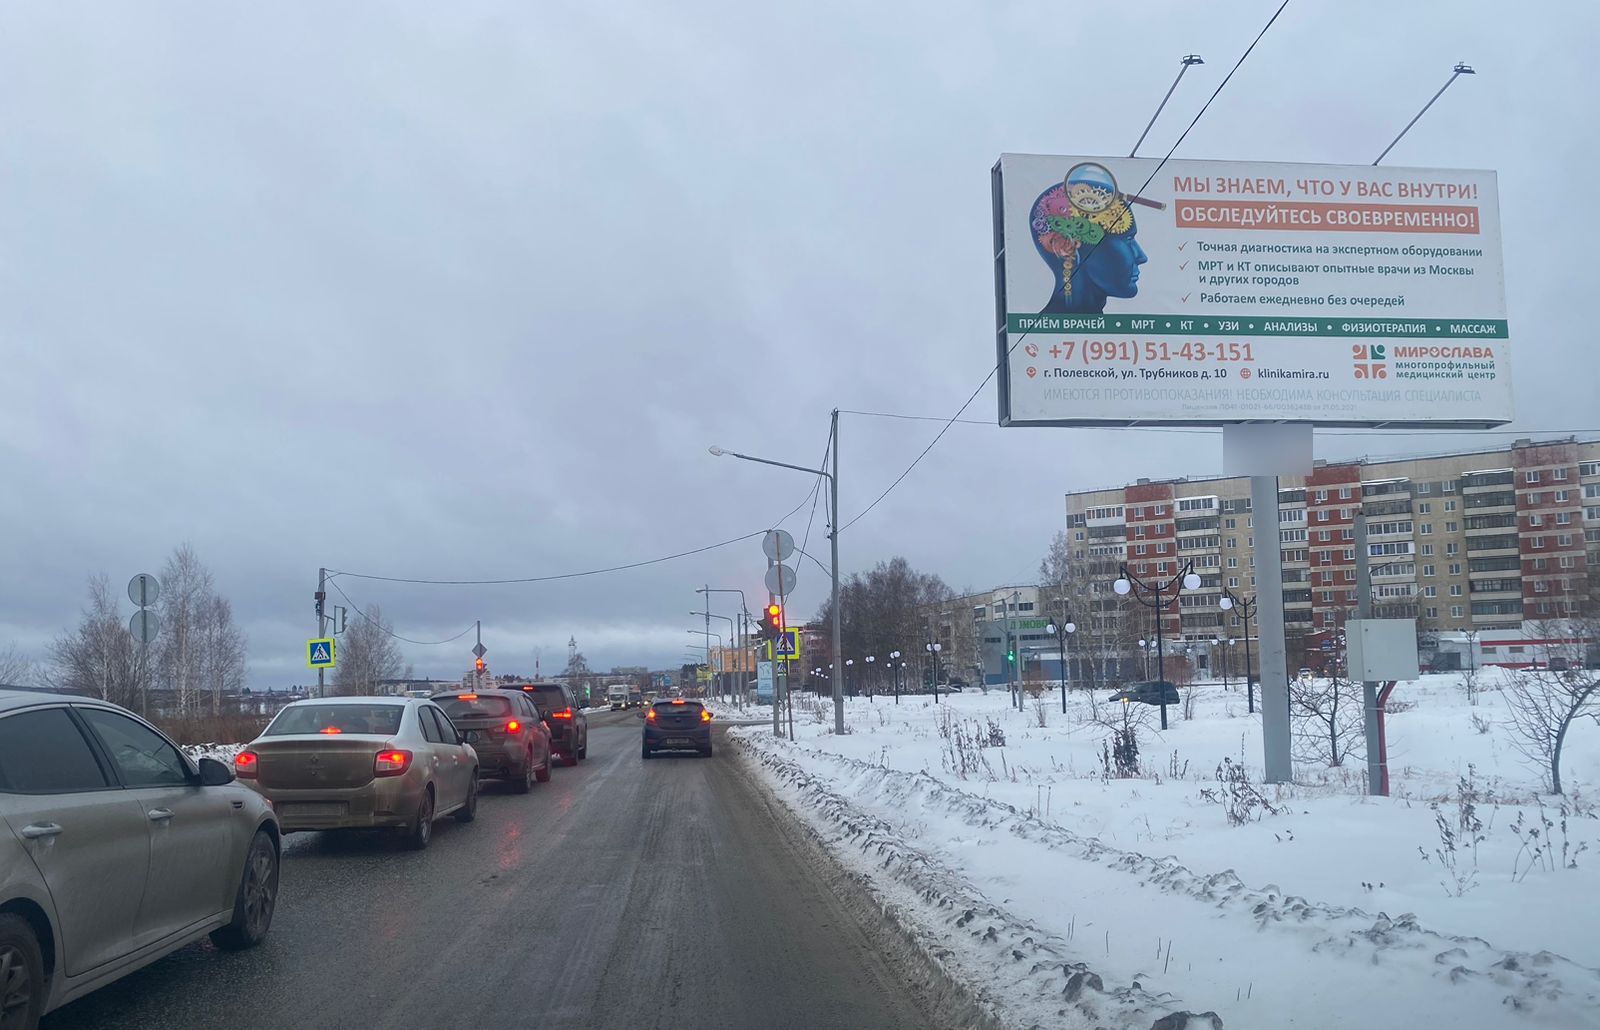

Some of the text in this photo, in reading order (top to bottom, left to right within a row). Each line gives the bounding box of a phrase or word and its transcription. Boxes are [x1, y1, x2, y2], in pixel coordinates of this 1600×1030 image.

[1174, 176, 1478, 199] МЫ ЗНАЕМ, ЧТО У ВАС ВНУТРИ!
[1181, 205, 1475, 228] ОБСЛЕДУЙТЕСЬ СВОЕВРЕМЕННО!
[1197, 241, 1483, 258] Точная диагностика на экспертном оборудовании
[1198, 261, 1474, 276] МРТ и КТ описывают опытные врачи из Москвы
[1199, 275, 1299, 287] и других городов
[1200, 293, 1405, 307] Работаем ежедневно без очередей
[1019, 317, 1496, 334] ПРИЁМ ВРАЧЕЙ МРТ КТ УЗИ АНАЛИЗЫ ФИЗИОТЕРАПИЯ МАССАЖ
[1049, 340, 1254, 364] +7 (991) 51-43-151
[1394, 346, 1494, 358] МИРОСЛАВА
[1395, 360, 1495, 370] многопрофильный
[1044, 367, 1227, 380] г. Полевской, ул. Трубников д. 10
[1258, 366, 1329, 379] klinikamira.ru
[1396, 370, 1496, 380] медицинский центр
[1044, 388, 1481, 402] ИМЕЮТСЯ ПРОТИВОПОКАЗАНИЯ! НЕОБХОДИМА КОНСУЛЬТАЦИЯ СПЕЦИАЛИСТА
